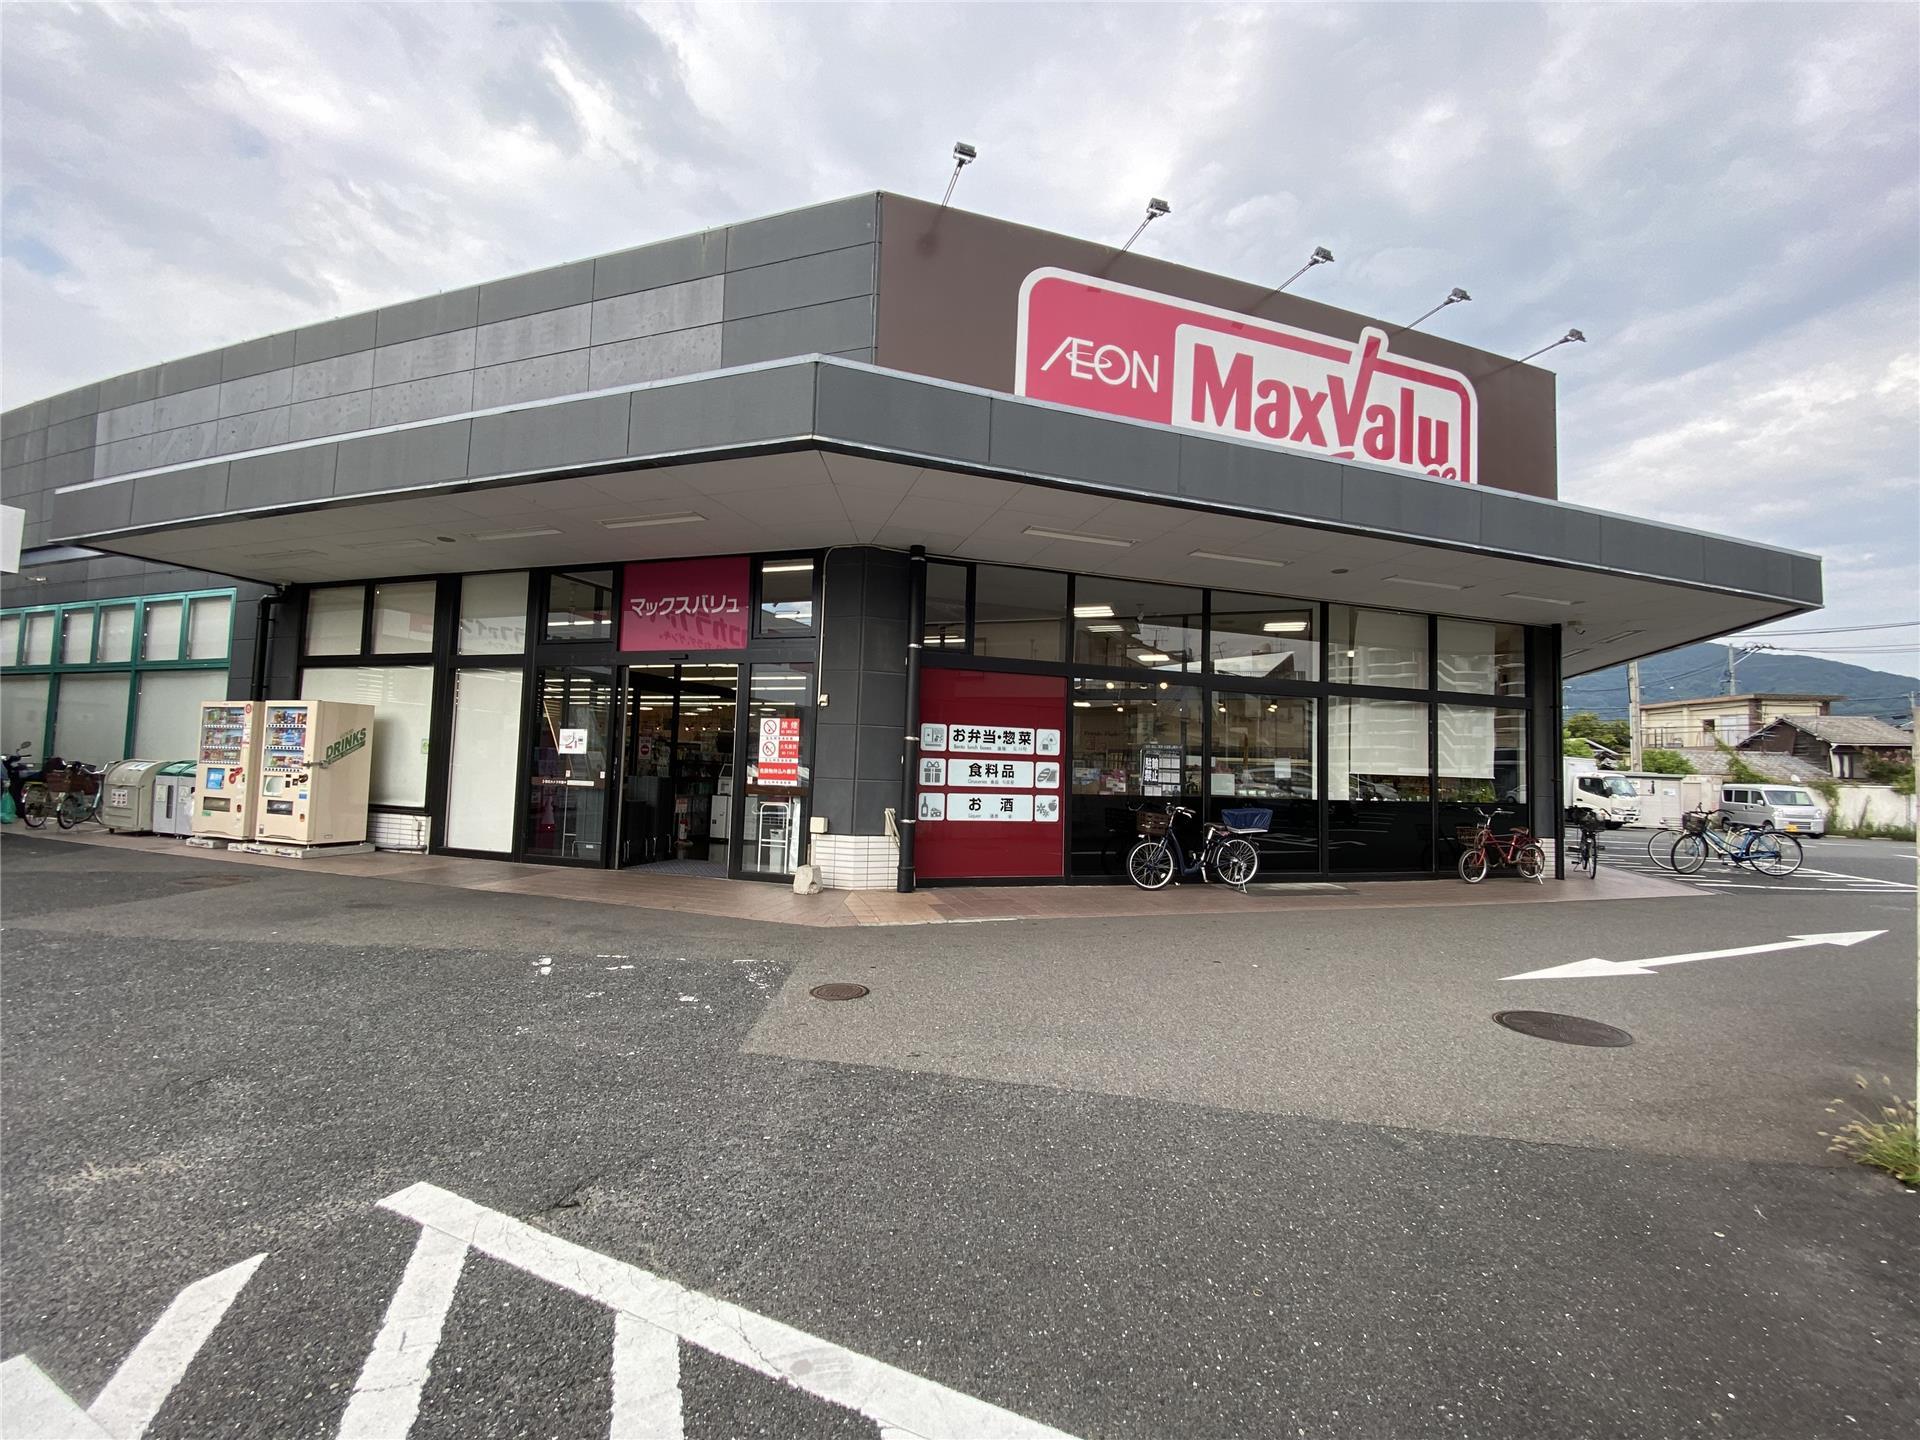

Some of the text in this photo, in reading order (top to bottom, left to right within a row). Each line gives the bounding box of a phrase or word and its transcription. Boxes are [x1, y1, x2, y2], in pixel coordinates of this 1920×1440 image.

[1191, 335, 1449, 468] MaxValu
[630, 594, 740, 617] マックスバリュ
[326, 727, 367, 760] DRINKS
[968, 762, 1015, 778] 食料品
